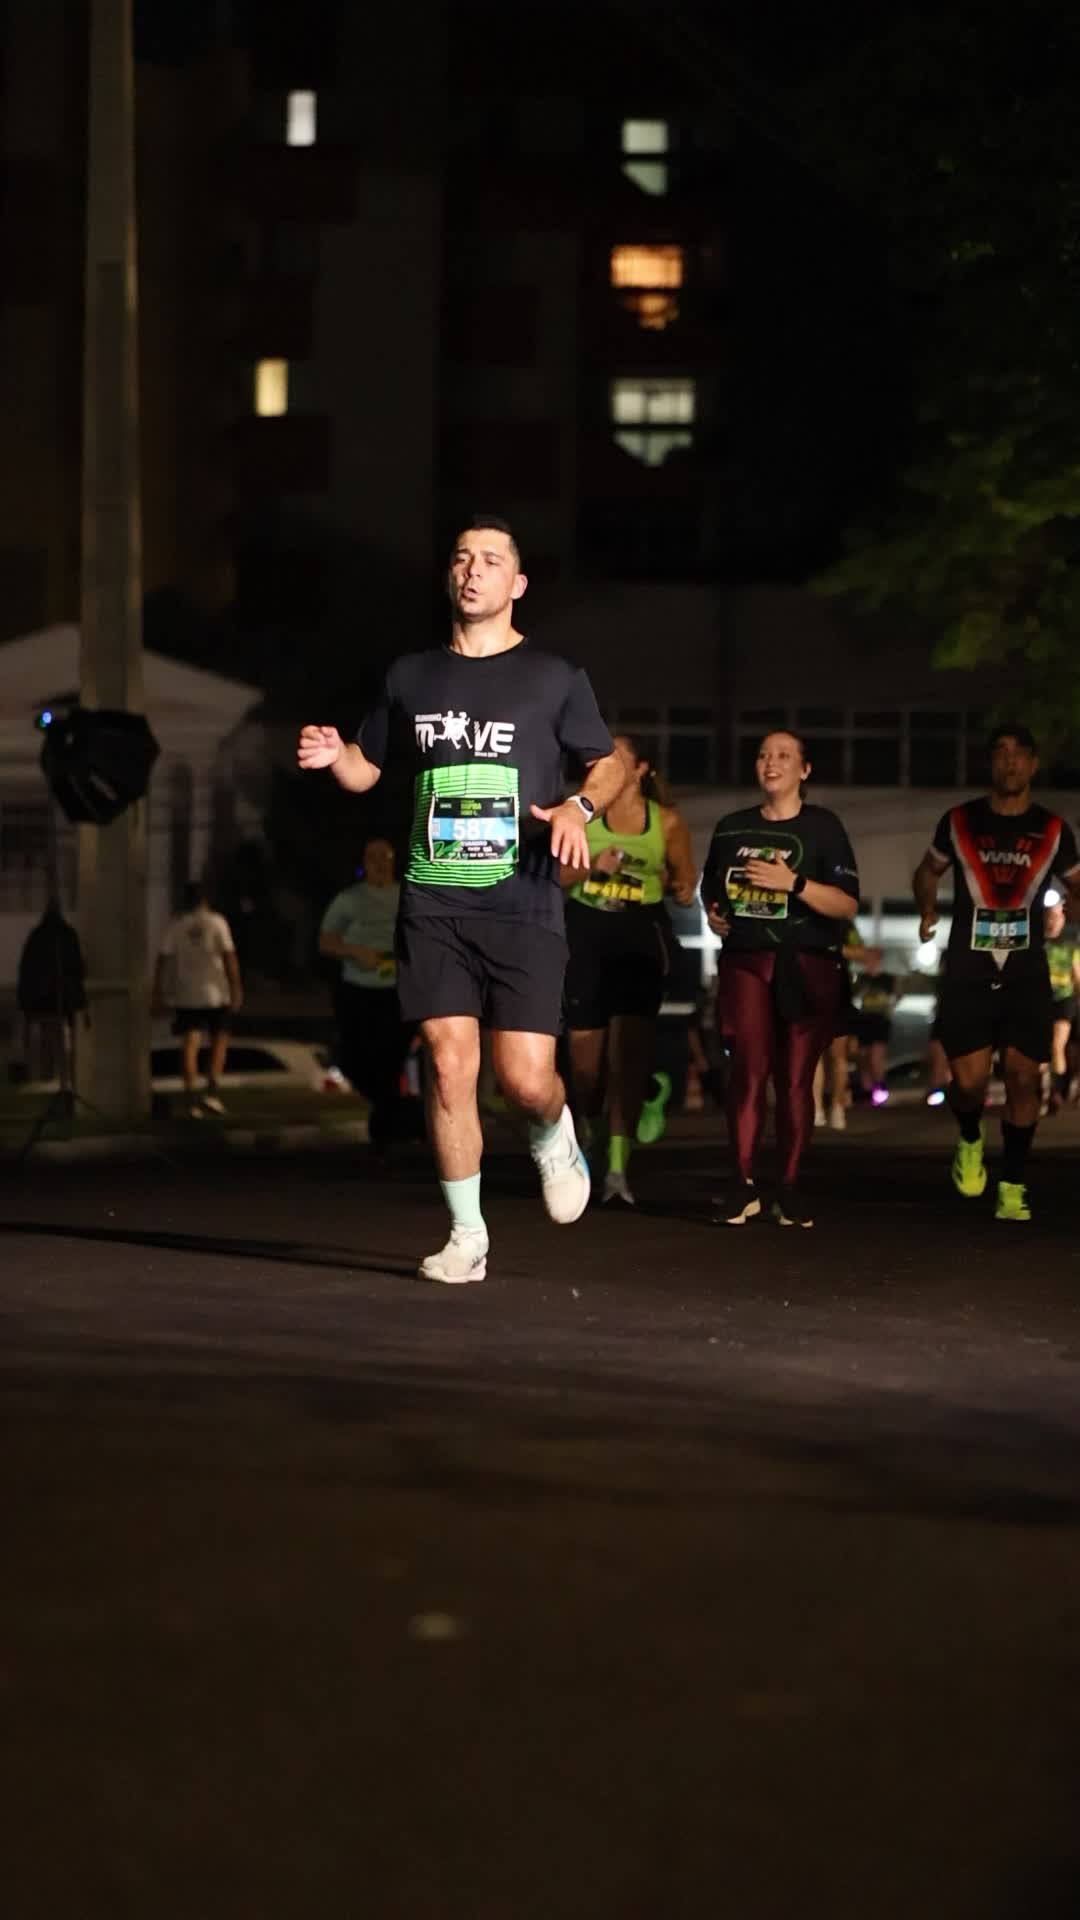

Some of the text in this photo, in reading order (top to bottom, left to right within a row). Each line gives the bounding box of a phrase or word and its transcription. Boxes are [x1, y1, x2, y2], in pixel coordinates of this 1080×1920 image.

[453, 817, 497, 840] 587
[979, 851, 1031, 868] VIANA
[990, 922, 1017, 936] 615
